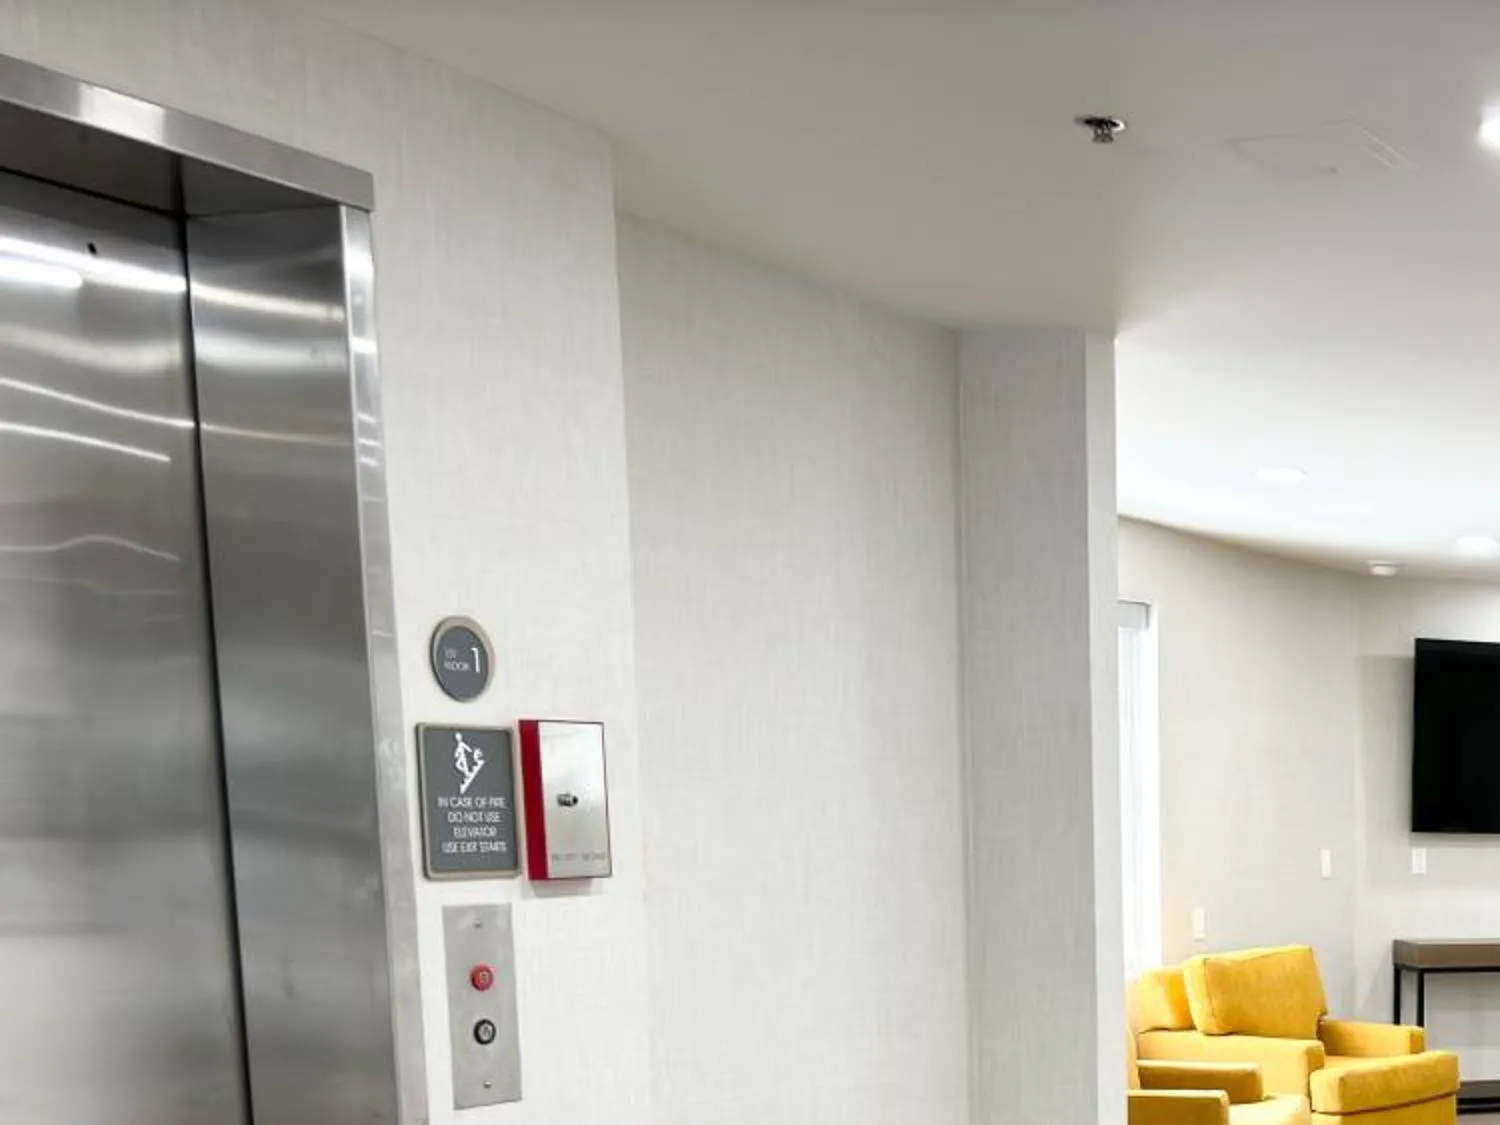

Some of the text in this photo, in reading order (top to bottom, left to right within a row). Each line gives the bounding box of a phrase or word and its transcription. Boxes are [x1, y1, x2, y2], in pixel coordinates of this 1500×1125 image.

[471, 647, 480, 673] 1
[449, 796, 473, 808] CASE
[474, 796, 487, 808] OF
[447, 811, 501, 823] DO NOT USE
[453, 826, 497, 838] ELEVATOR
[442, 842, 458, 854] USE
